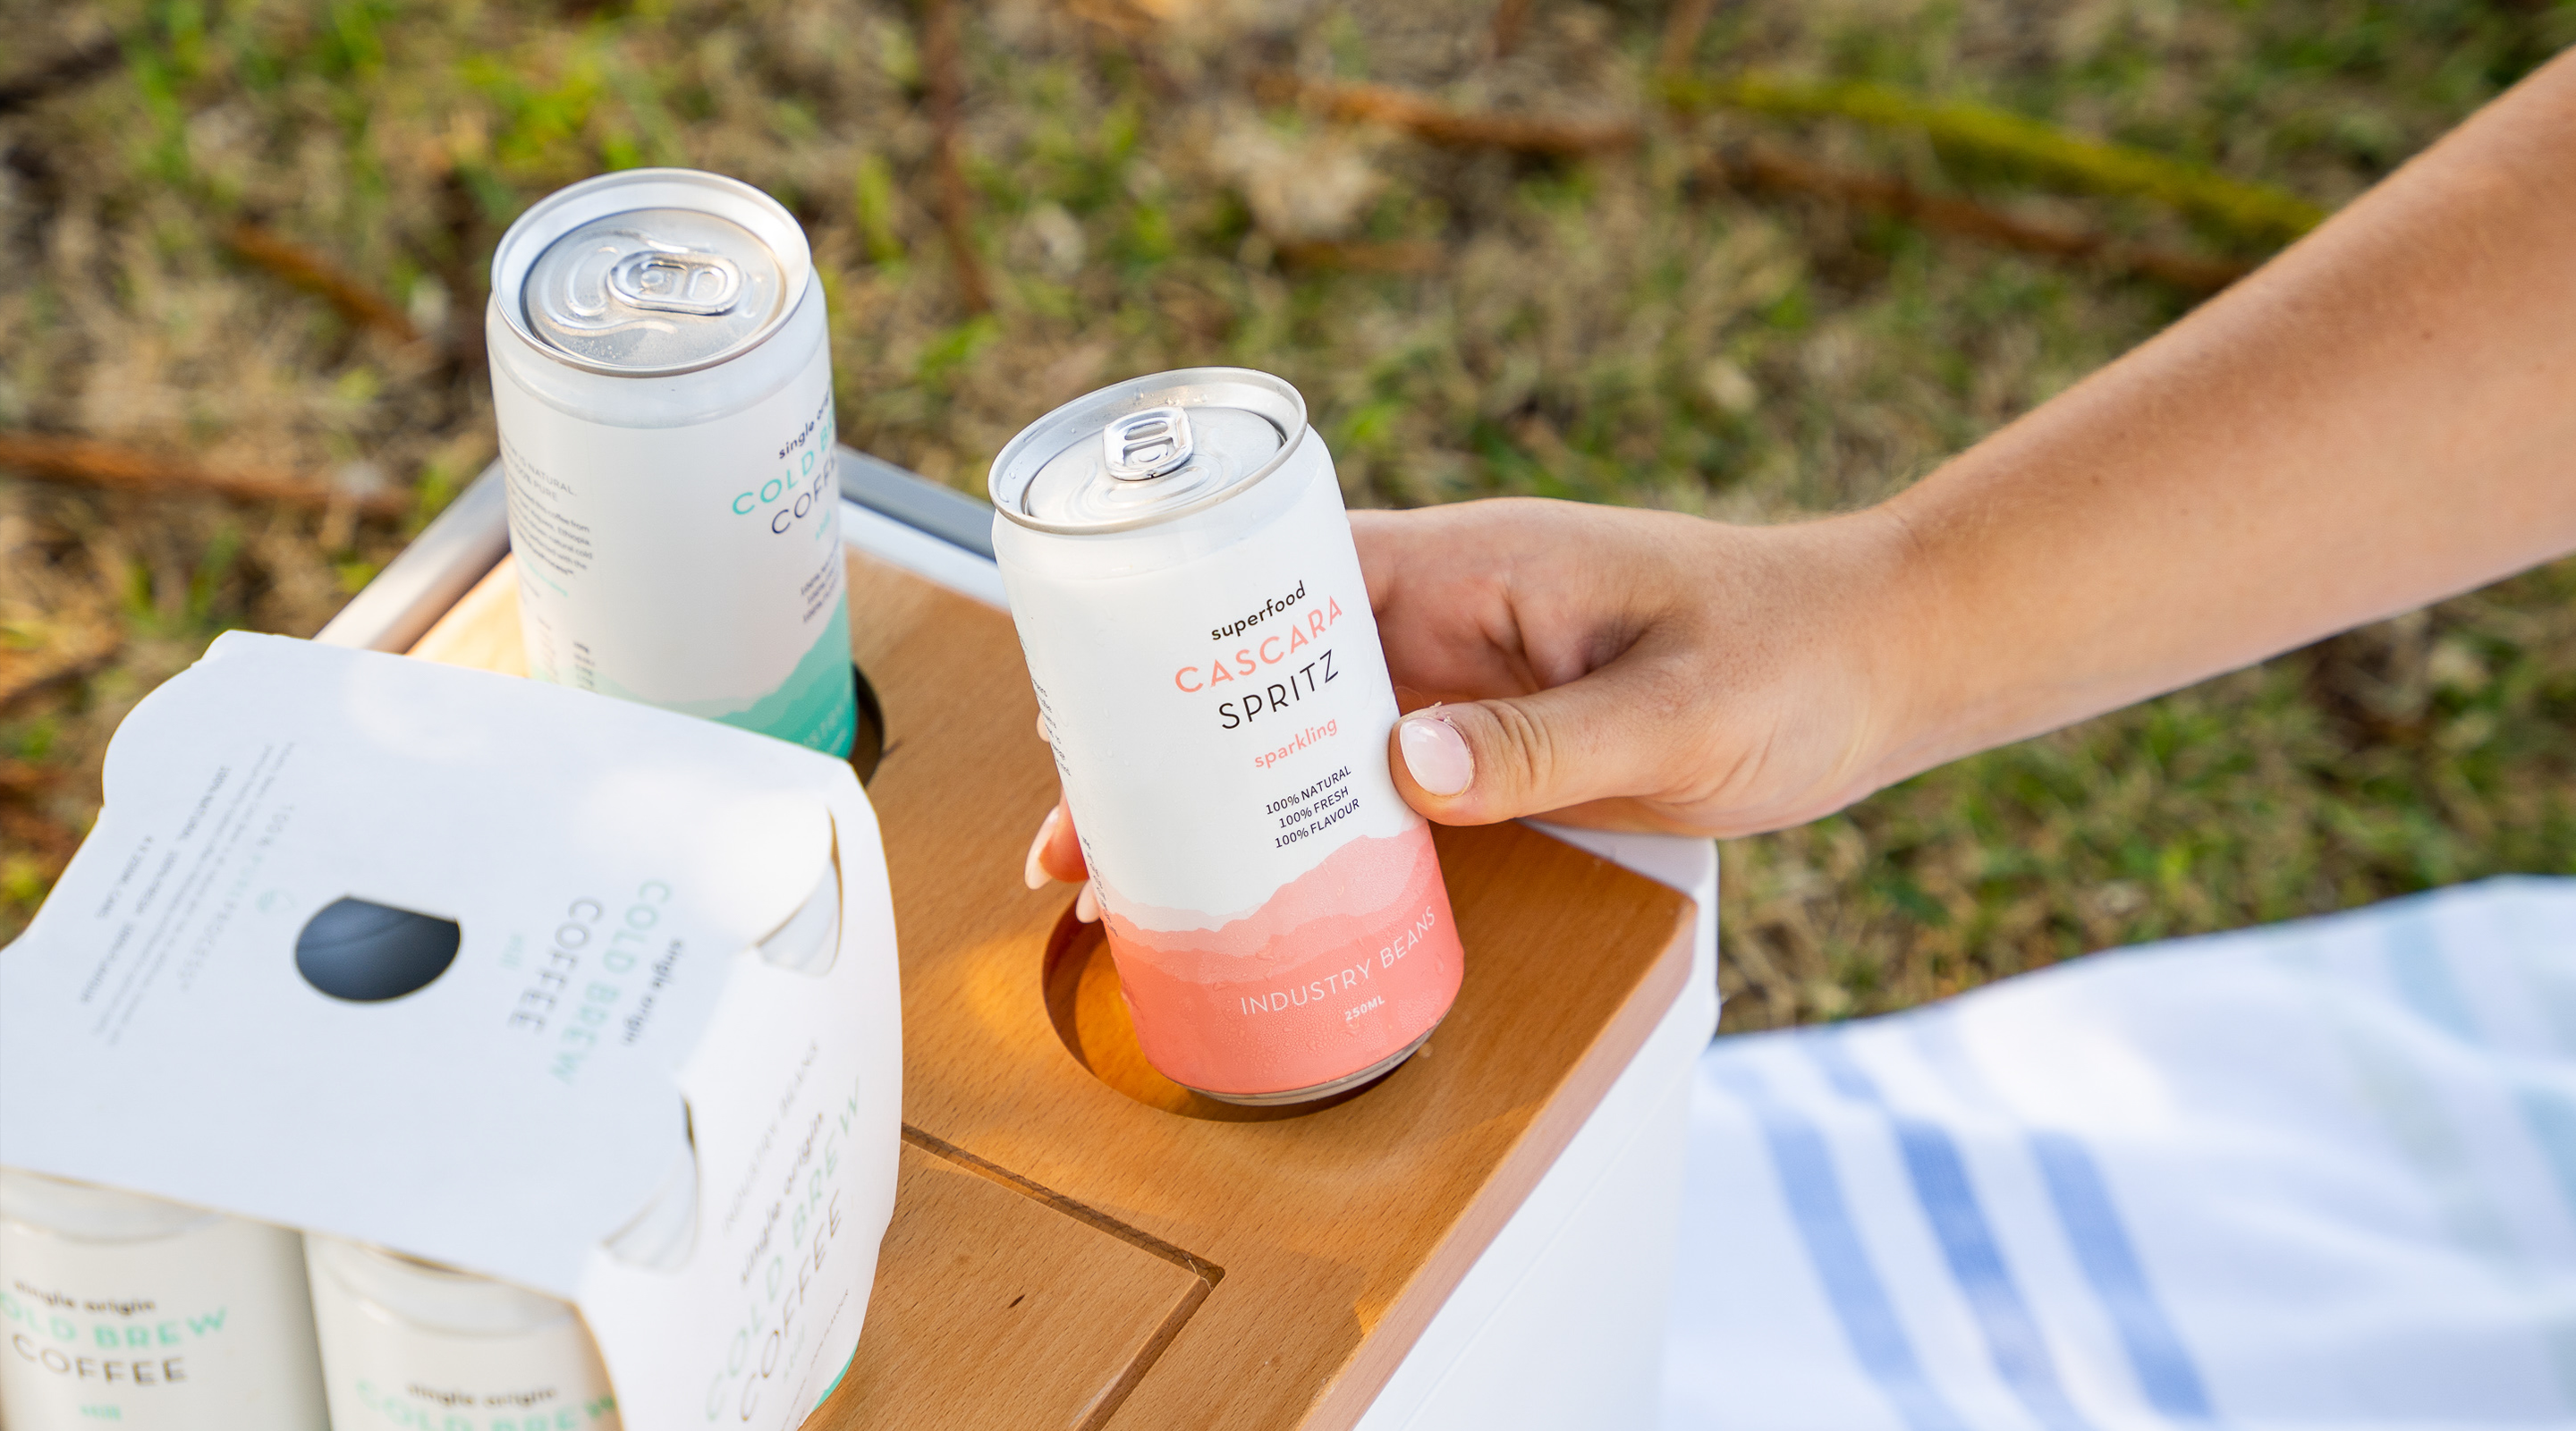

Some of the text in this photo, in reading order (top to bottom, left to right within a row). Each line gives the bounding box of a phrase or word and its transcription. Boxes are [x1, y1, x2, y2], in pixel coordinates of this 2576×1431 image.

[779, 421, 814, 459] single
[732, 450, 814, 515] COLD
[772, 451, 835, 534] COFF
[1211, 580, 1306, 641] superfood
[1174, 595, 1343, 693] CASCARA
[1218, 649, 1339, 730] SPRITZ
[1254, 718, 1338, 768] sparkling
[1266, 765, 1352, 815] 100% NATURAL
[1278, 786, 1349, 829] 100% FRESH
[1275, 798, 1360, 849] 100% FLAVOUR
[602, 879, 672, 973] COLD
[507, 896, 604, 1035] COFFEE
[1241, 905, 1436, 1016] INDUSTRY BEANS
[1345, 995, 1385, 1021] 250ML
[784, 1113, 822, 1195] origin
[706, 1256, 783, 1422] COLD
[792, 1075, 859, 1249] BREW
[0, 1291, 227, 1349] OLD BREW
[741, 1189, 842, 1421] COFFEE
[13, 1334, 187, 1386] COFFEE
